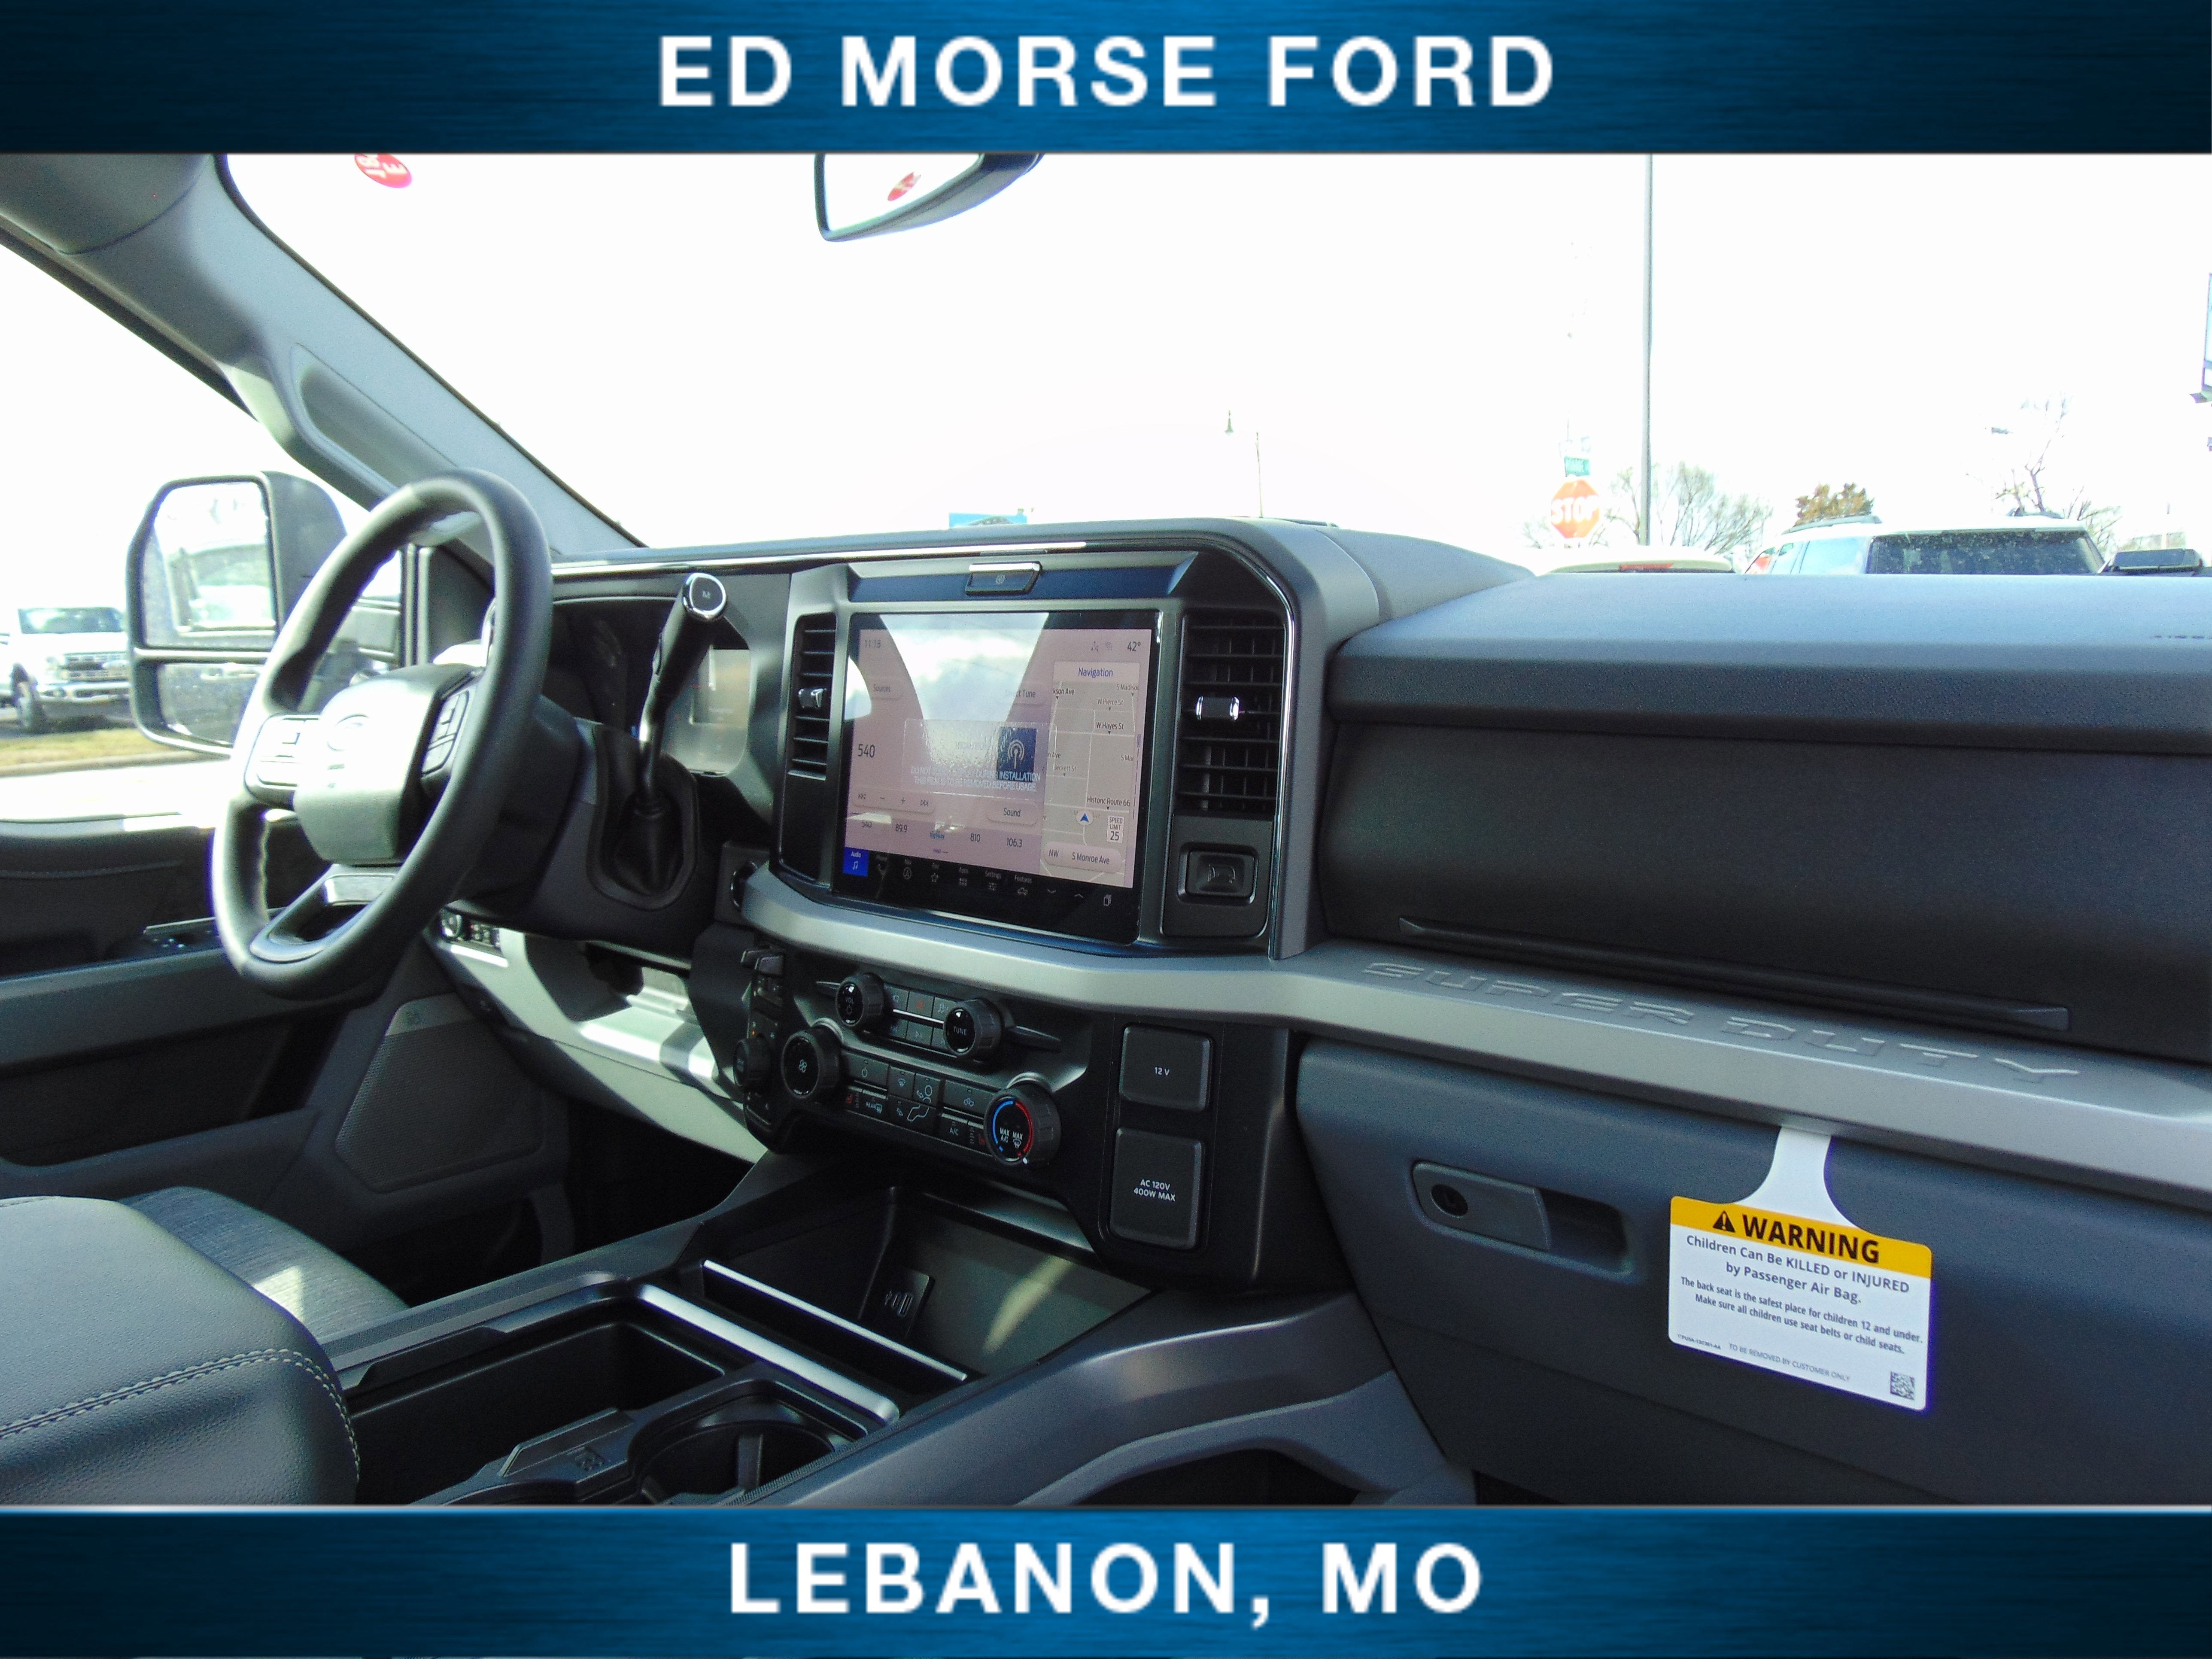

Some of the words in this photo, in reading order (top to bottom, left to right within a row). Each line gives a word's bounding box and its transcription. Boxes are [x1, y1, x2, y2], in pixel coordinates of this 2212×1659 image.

[1551, 496, 1599, 523] STOP
[1127, 641, 1141, 651] 42°
[1078, 668, 1113, 678] Navigation
[873, 684, 890, 692] Sources
[858, 744, 875, 758] 540
[999, 772, 1041, 781] INSTALLATION
[992, 781, 1015, 790] BEFORE
[1016, 782, 1036, 791] USAGE
[1087, 796, 1106, 805] Historic
[1003, 808, 1021, 817] Sound
[896, 823, 907, 833] 89.9
[970, 833, 981, 842] 810
[1110, 831, 1119, 841] 25
[1007, 838, 1022, 848] 106.3
[1049, 849, 1059, 857] NW
[1077, 853, 1098, 862] Monroe
[1099, 856, 1110, 864] Ave
[985, 870, 1001, 879] Settings
[1015, 875, 1032, 884] Features
[1362, 962, 1695, 1025] SUPER
[1722, 1017, 2080, 1083] DUTY
[954, 1026, 967, 1035] TUNE
[1155, 1067, 1162, 1075] 12
[949, 1127, 958, 1136] A/C
[1000, 1127, 1009, 1136] MAX
[1012, 1131, 1023, 1140] MAX
[1140, 1179, 1150, 1187] AC
[1152, 1181, 1170, 1191] 120V
[1133, 1188, 1156, 1197] 400W
[1158, 1191, 1176, 1202] MAX
[1742, 1213, 1879, 1264] WARNING
[1687, 1235, 1736, 1255] Children
[1740, 1246, 1763, 1261] Can
[1767, 1252, 1782, 1265] Be
[1786, 1257, 1830, 1276] KILLED
[1834, 1269, 1847, 1279] or
[1852, 1271, 1910, 1293] INJURED
[1726, 1261, 1740, 1276] by
[1744, 1266, 1807, 1290] Passenger
[1811, 1282, 1829, 1294] Air
[1834, 1287, 1861, 1305] Bag.
[1681, 1276, 1695, 1287] The
[1697, 1279, 1714, 1292] back
[1717, 1286, 1732, 1297] seat
[1735, 1289, 1741, 1299] is
[1744, 1292, 1756, 1303] the
[1759, 1297, 1782, 1310] safest
[1785, 1303, 1806, 1315] place
[1808, 1307, 1821, 1319] for
[1823, 1312, 1858, 1328] children
[1861, 1320, 1871, 1331] 12
[1874, 1325, 1890, 1335] and
[1893, 1330, 1922, 1343] under.
[1695, 1293, 1716, 1306] Make
[1719, 1300, 1735, 1311] sure
[1738, 1305, 1747, 1314] all
[1750, 1308, 1781, 1323] children
[1784, 1318, 1798, 1327] use
[1801, 1321, 1817, 1332] seat
[1820, 1325, 1841, 1338] belts
[1844, 1333, 1853, 1341] or
[1856, 1334, 1876, 1347] child
[1879, 1341, 1905, 1354] seats.
[1729, 1343, 1738, 1351] TO
[1740, 1346, 1747, 1354] BE
[1749, 1348, 1781, 1363] REMOVED
[1782, 1358, 1790, 1366] BY
[1792, 1361, 1829, 1376] CUSTOMER
[1831, 1370, 1850, 1381] ONLY
